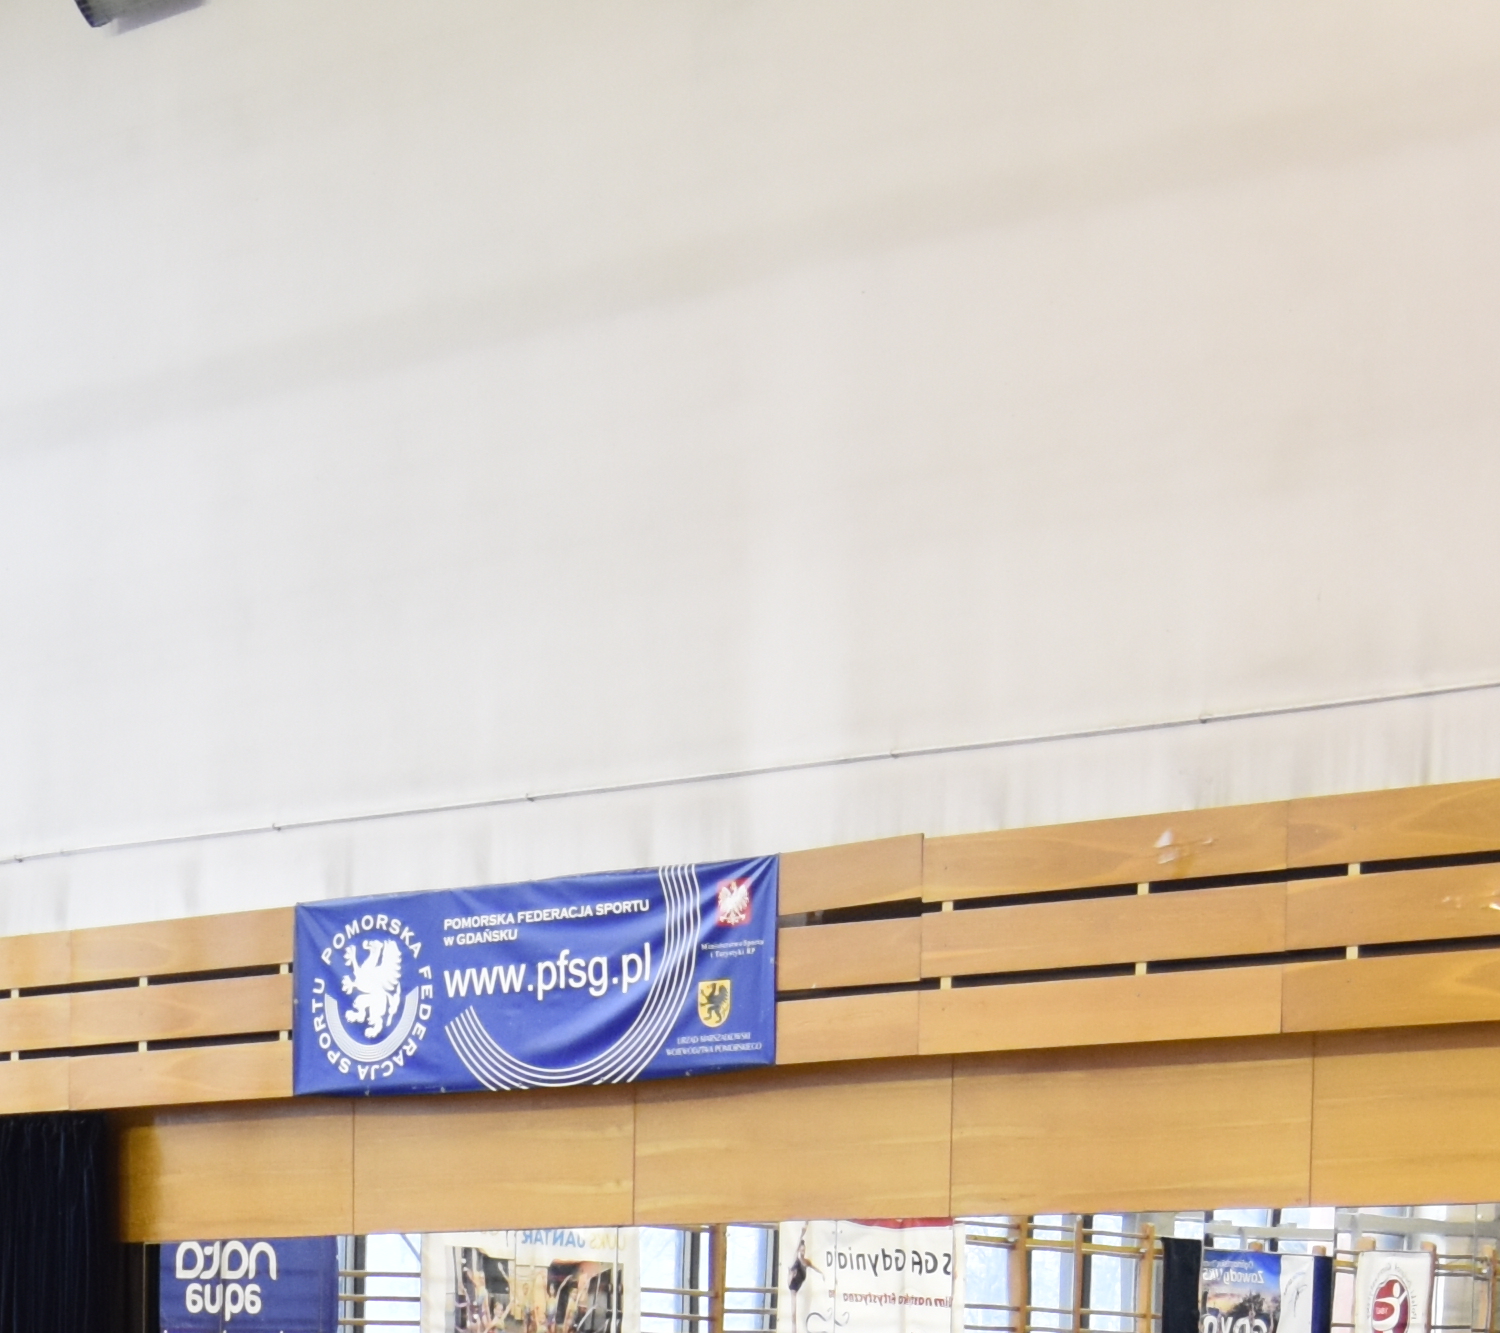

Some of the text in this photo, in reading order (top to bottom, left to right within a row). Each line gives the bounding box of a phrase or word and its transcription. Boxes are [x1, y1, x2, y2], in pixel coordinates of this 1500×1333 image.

[443, 898, 650, 930] POMORSKA FEDERACJA SPORTU
[456, 928, 518, 946] GDAŃSKU
[443, 942, 651, 1001] www.pfsg.pl
[311, 913, 433, 1081] POMORSKA FEDERACJA SPORTU
